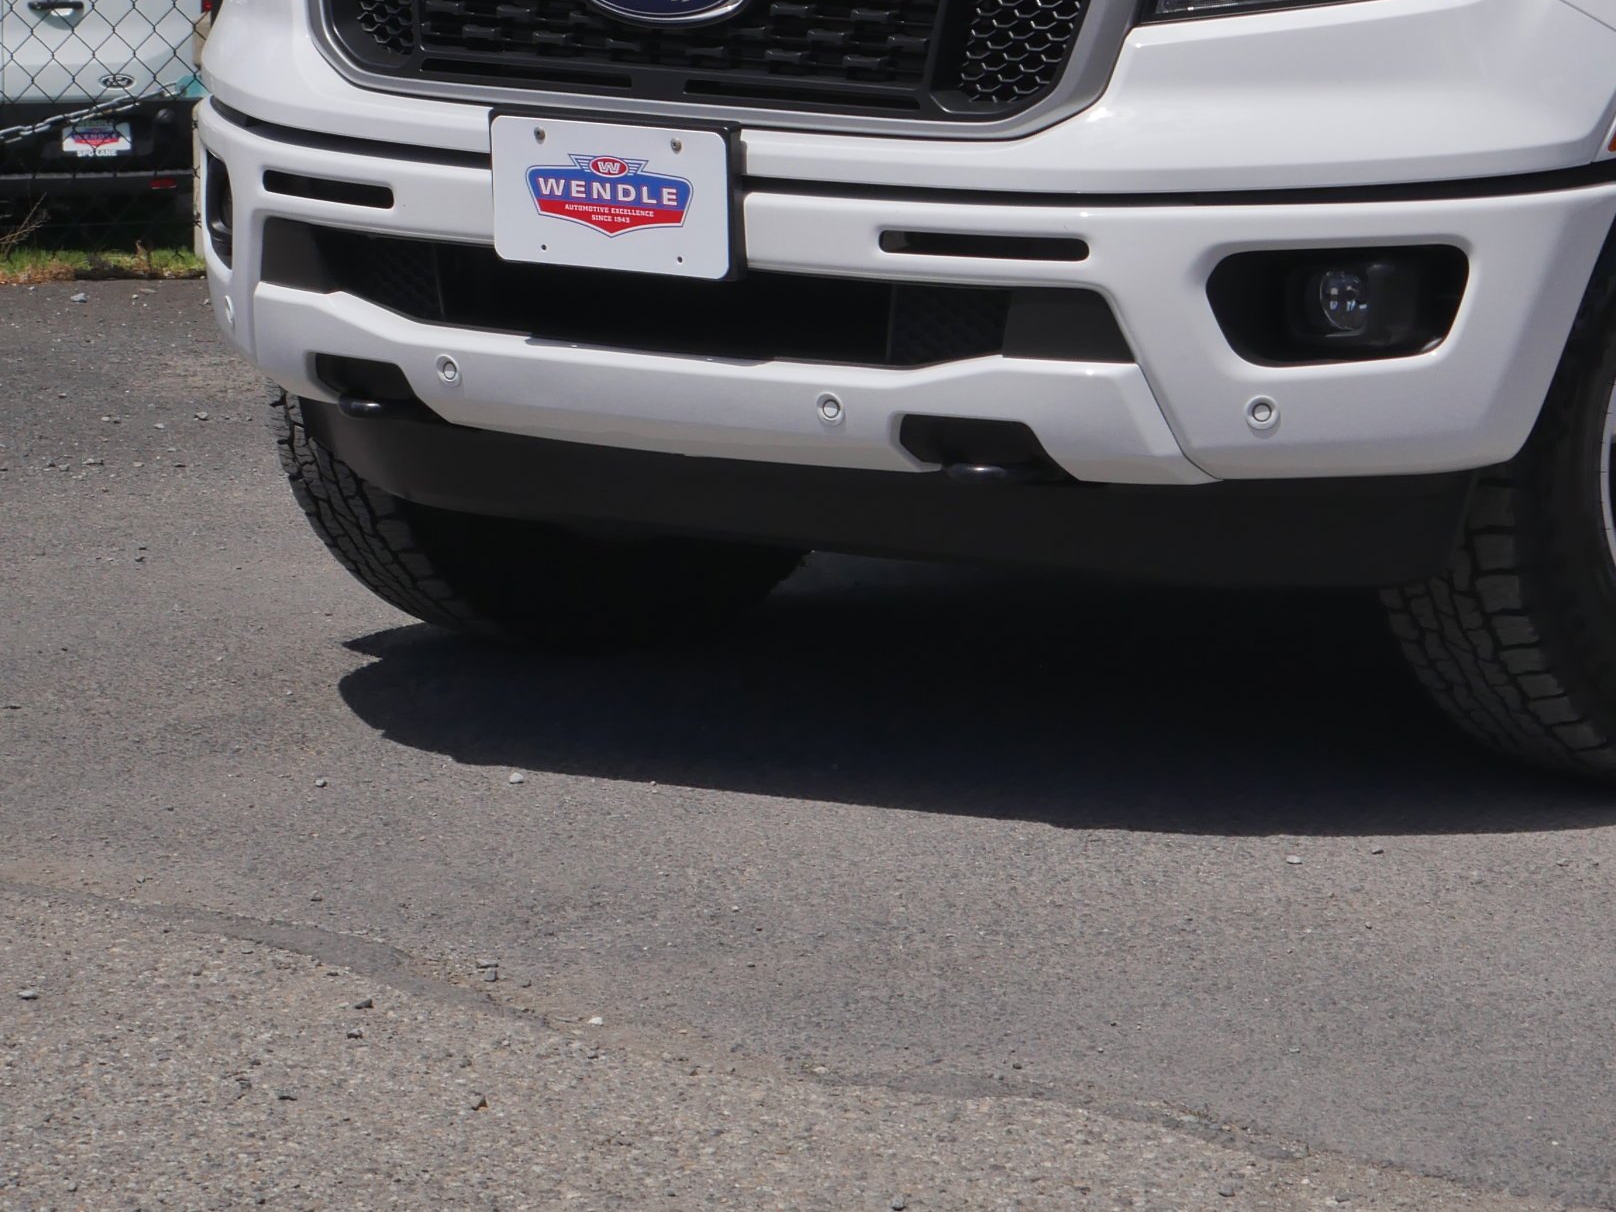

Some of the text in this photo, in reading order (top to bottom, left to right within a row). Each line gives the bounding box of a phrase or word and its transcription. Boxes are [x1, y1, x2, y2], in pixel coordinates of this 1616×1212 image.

[538, 177, 678, 206] WENDLE
[564, 203, 655, 218] AUTOMOTIVE EXCELLENCE
[591, 214, 612, 222] SINCE
